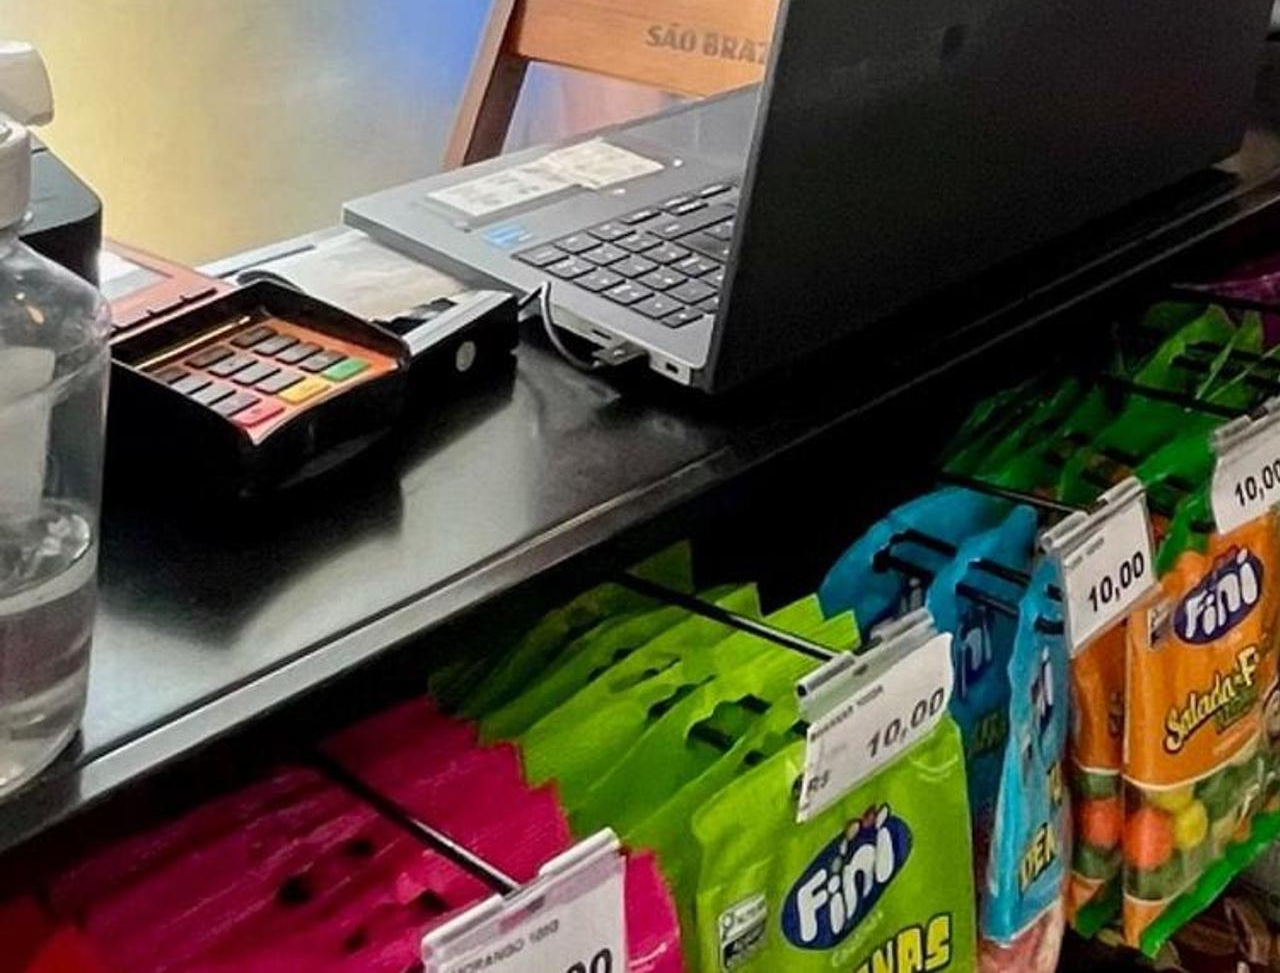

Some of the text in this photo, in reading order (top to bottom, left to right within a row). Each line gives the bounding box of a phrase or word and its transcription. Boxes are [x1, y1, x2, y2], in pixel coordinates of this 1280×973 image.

[1088, 550, 1145, 613] 10,00
[1185, 547, 1258, 639] Fini
[867, 687, 945, 758] 10,00
[795, 806, 896, 943] Fini
